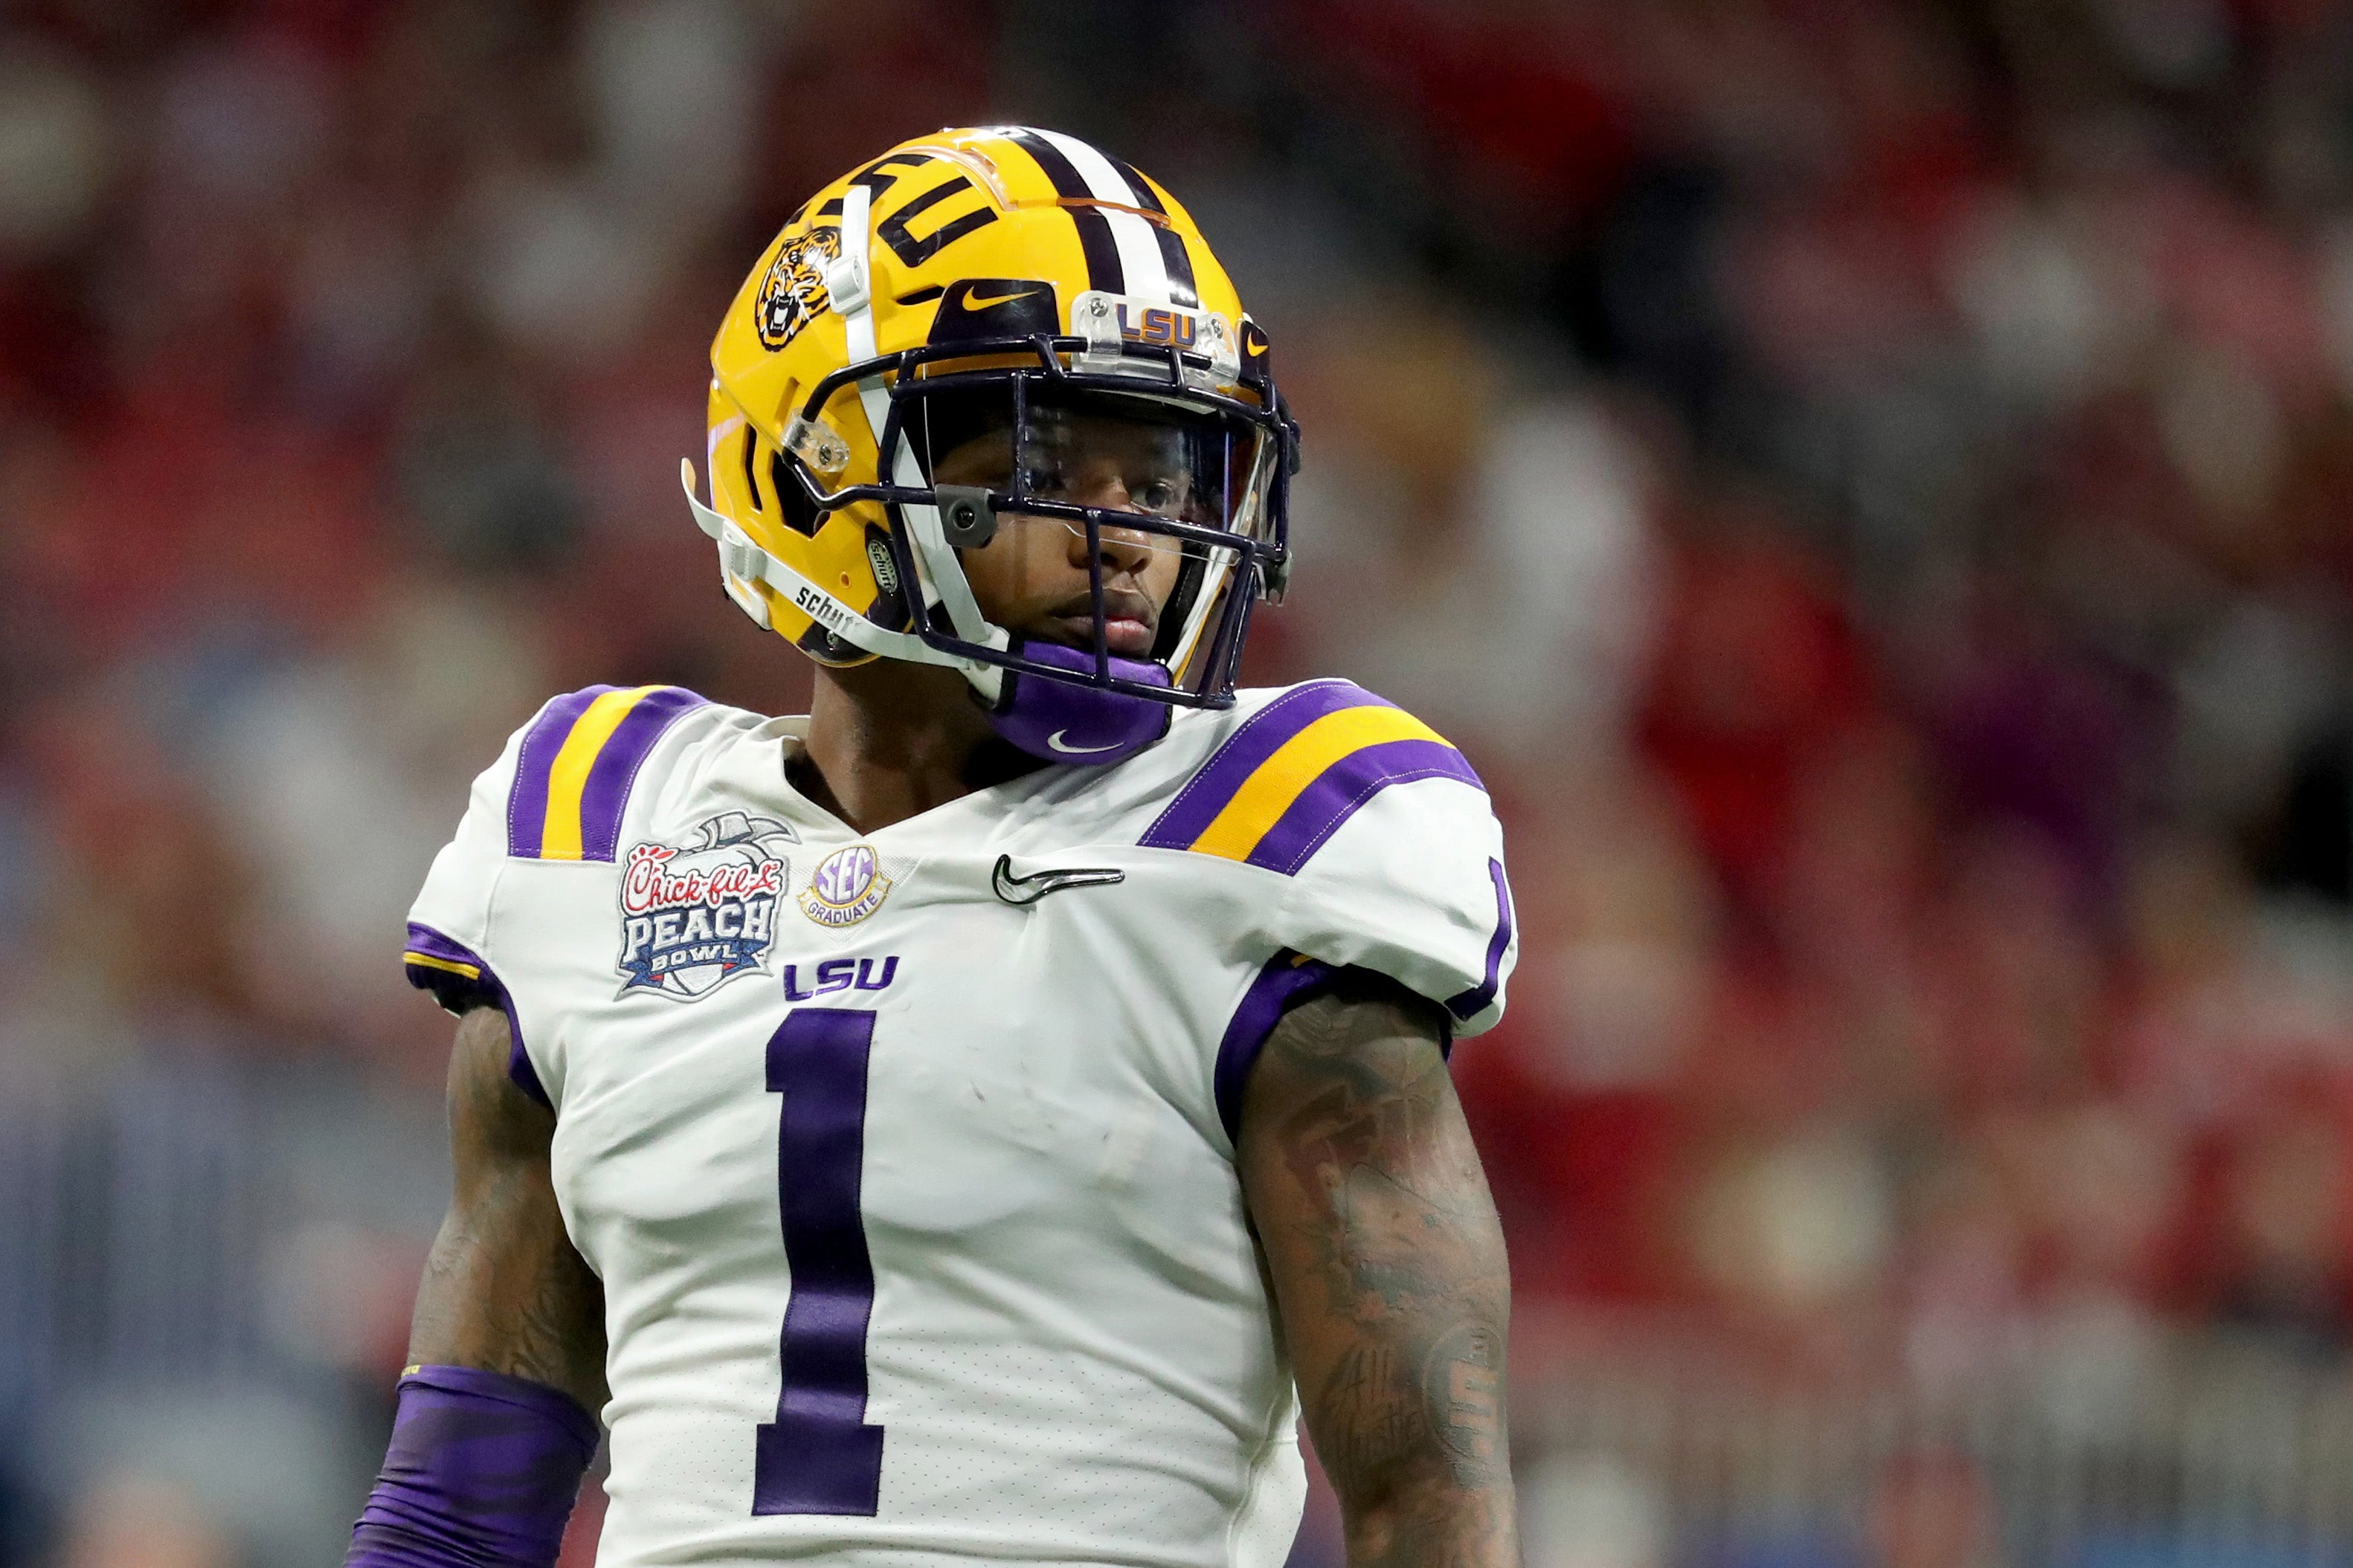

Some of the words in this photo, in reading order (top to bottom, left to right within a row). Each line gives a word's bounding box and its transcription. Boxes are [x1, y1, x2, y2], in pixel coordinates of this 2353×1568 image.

[1116, 303, 1196, 349] LSU
[817, 846, 872, 903] SEC
[622, 899, 776, 963] PEACH
[808, 893, 878, 923] GRADUATE
[651, 944, 738, 972] BOWL
[783, 956, 900, 1001] LSU
[751, 1007, 884, 1517] 1
